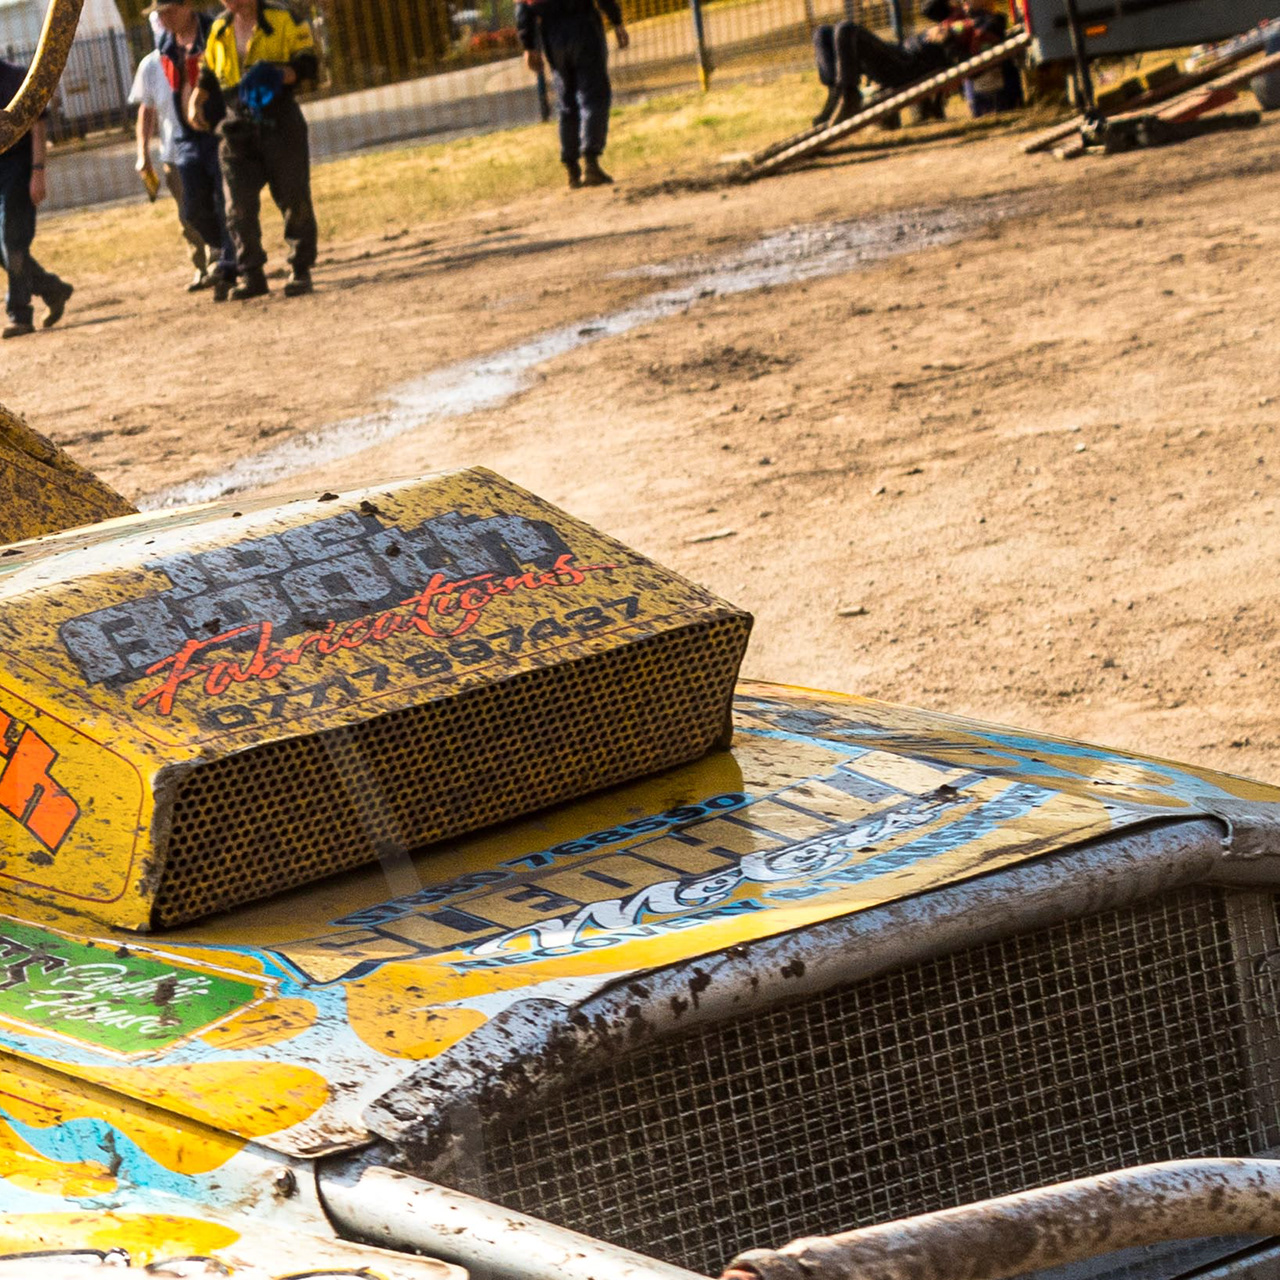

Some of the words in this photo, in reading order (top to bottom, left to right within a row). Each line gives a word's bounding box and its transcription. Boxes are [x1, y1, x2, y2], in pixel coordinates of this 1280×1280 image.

[138, 553, 623, 715] Fabrications
[204, 664, 392, 732] 07717
[404, 595, 644, 680] 897437
[444, 898, 776, 975] RECOVERY
[810, 782, 1062, 886] TRANSPORT
[470, 795, 978, 960] Motors
[499, 790, 759, 872] 768590
